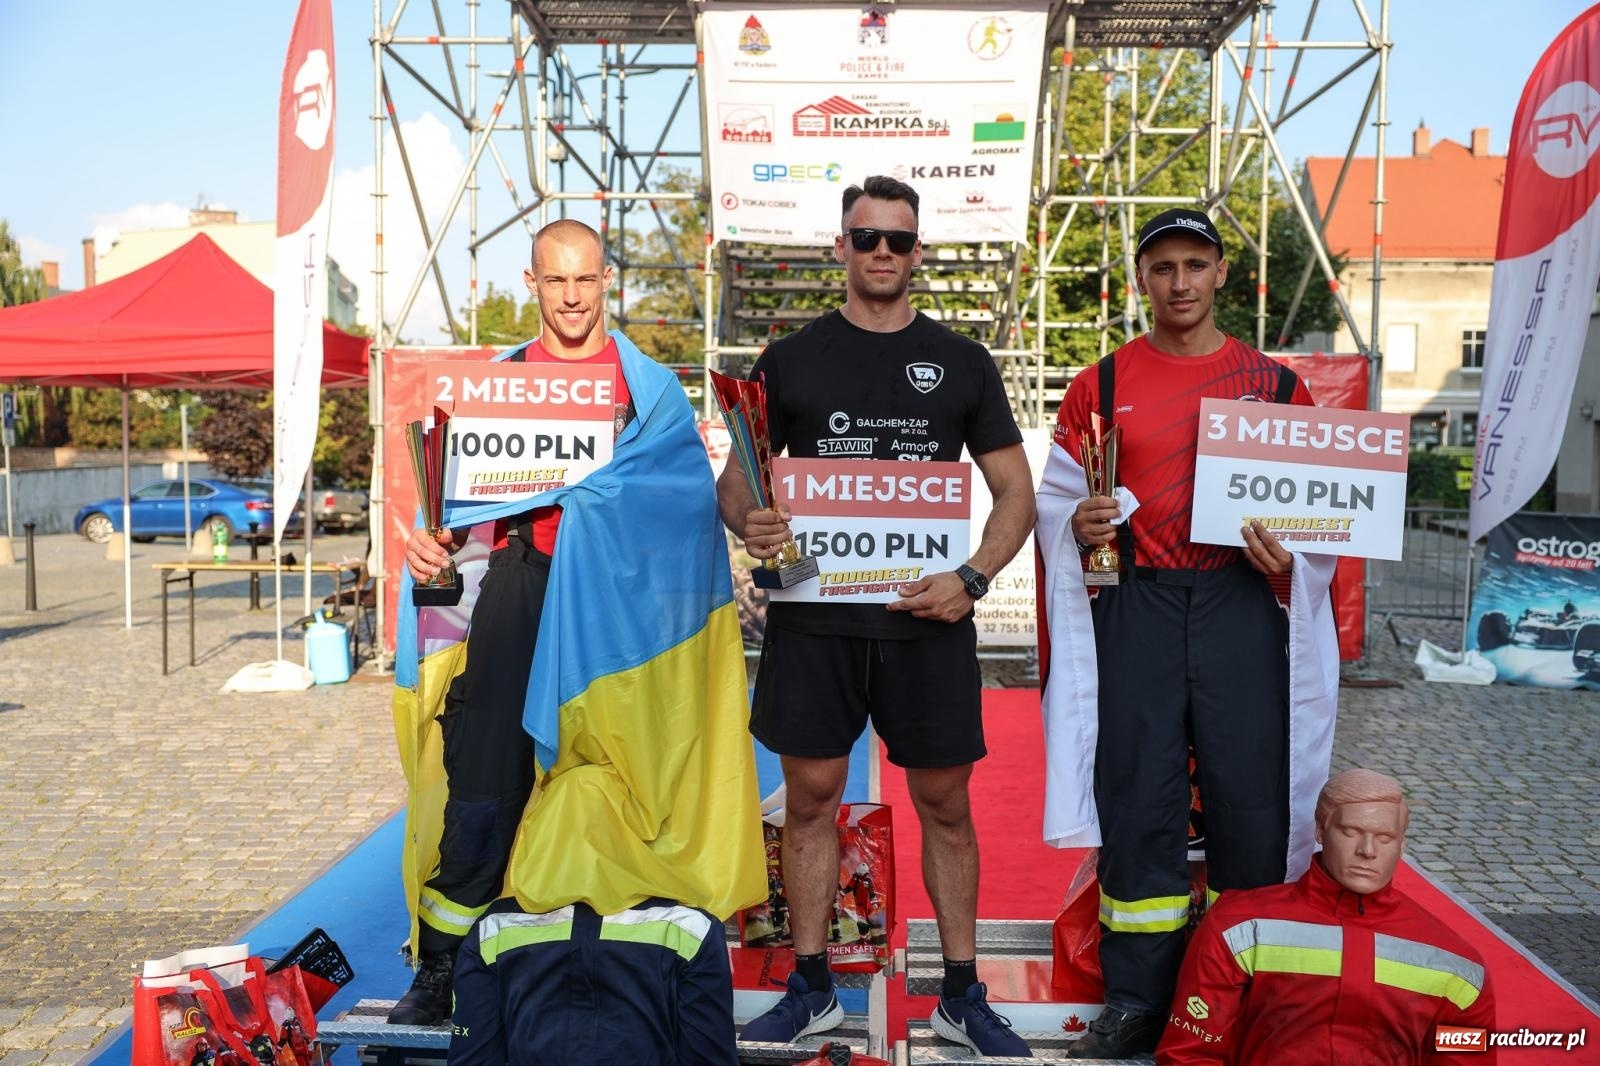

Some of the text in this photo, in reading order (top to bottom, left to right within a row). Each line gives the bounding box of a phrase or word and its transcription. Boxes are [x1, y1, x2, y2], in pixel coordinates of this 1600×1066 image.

[840, 62, 872, 72] POLICE
[885, 62, 905, 72] FIRE
[834, 117, 923, 129] KAMPKA
[928, 119, 950, 132] Sp.j.
[972, 147, 1020, 155] AGROMAX
[911, 164, 995, 179] KAREN
[742, 199, 797, 208] TOKAI COBEX
[1176, 218, 1206, 230] Dräger
[1478, 259, 1552, 501] VANESSA
[434, 375, 612, 406] 2 MIEJSCE
[857, 418, 928, 428] GALCHEM-ZAP
[1207, 413, 1404, 456] 3 MIEJSCE
[451, 431, 595, 461] 1000 PLN
[817, 439, 870, 453] STAWIK
[891, 439, 928, 452] Armor
[469, 466, 568, 484] TOUGHEST
[782, 474, 963, 503] 1 MIEJSCE
[1227, 473, 1375, 511] 500 PLN
[1271, 531, 1351, 541] EFIGHTER
[795, 531, 949, 559] 1500 PLN
[1517, 536, 1600, 567] ostrog
[820, 566, 924, 585] TOUGHEST
[820, 580, 918, 596] FIREFIGHT
[980, 596, 1035, 606] Racibórz
[976, 609, 1029, 619] Sudecka
[984, 623, 1035, 633] 32 755 18
[453, 1025, 469, 1037] EX
